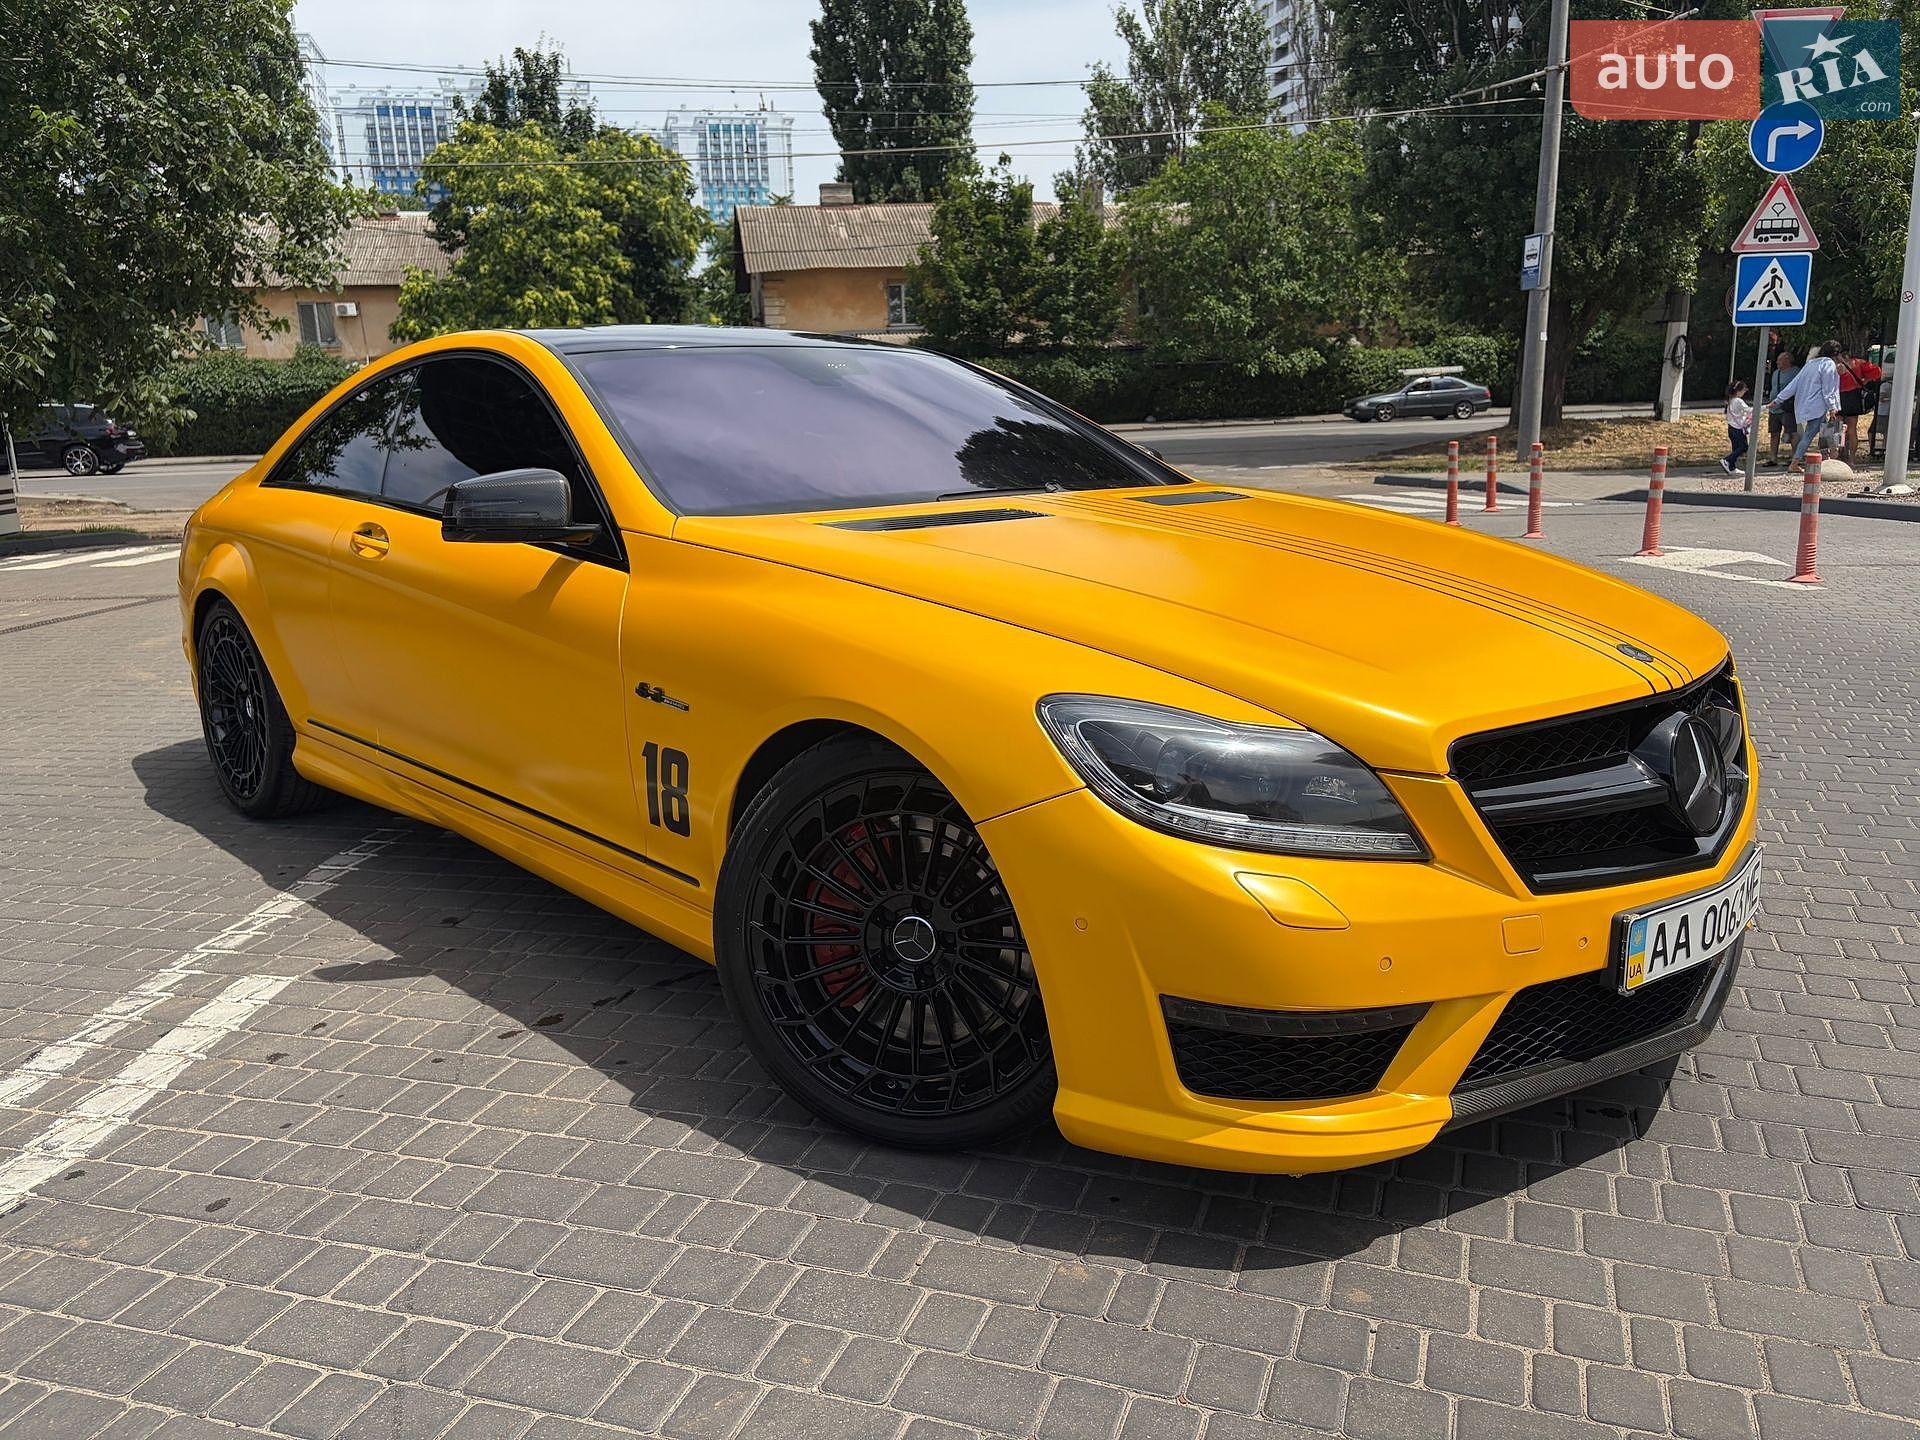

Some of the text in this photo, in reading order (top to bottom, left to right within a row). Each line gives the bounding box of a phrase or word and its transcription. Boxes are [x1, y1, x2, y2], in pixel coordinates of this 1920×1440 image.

[642, 741, 690, 837] 18
[1628, 963, 1642, 979] UA
[1648, 914, 1691, 973] AA
[1701, 881, 1746, 951] 0063
